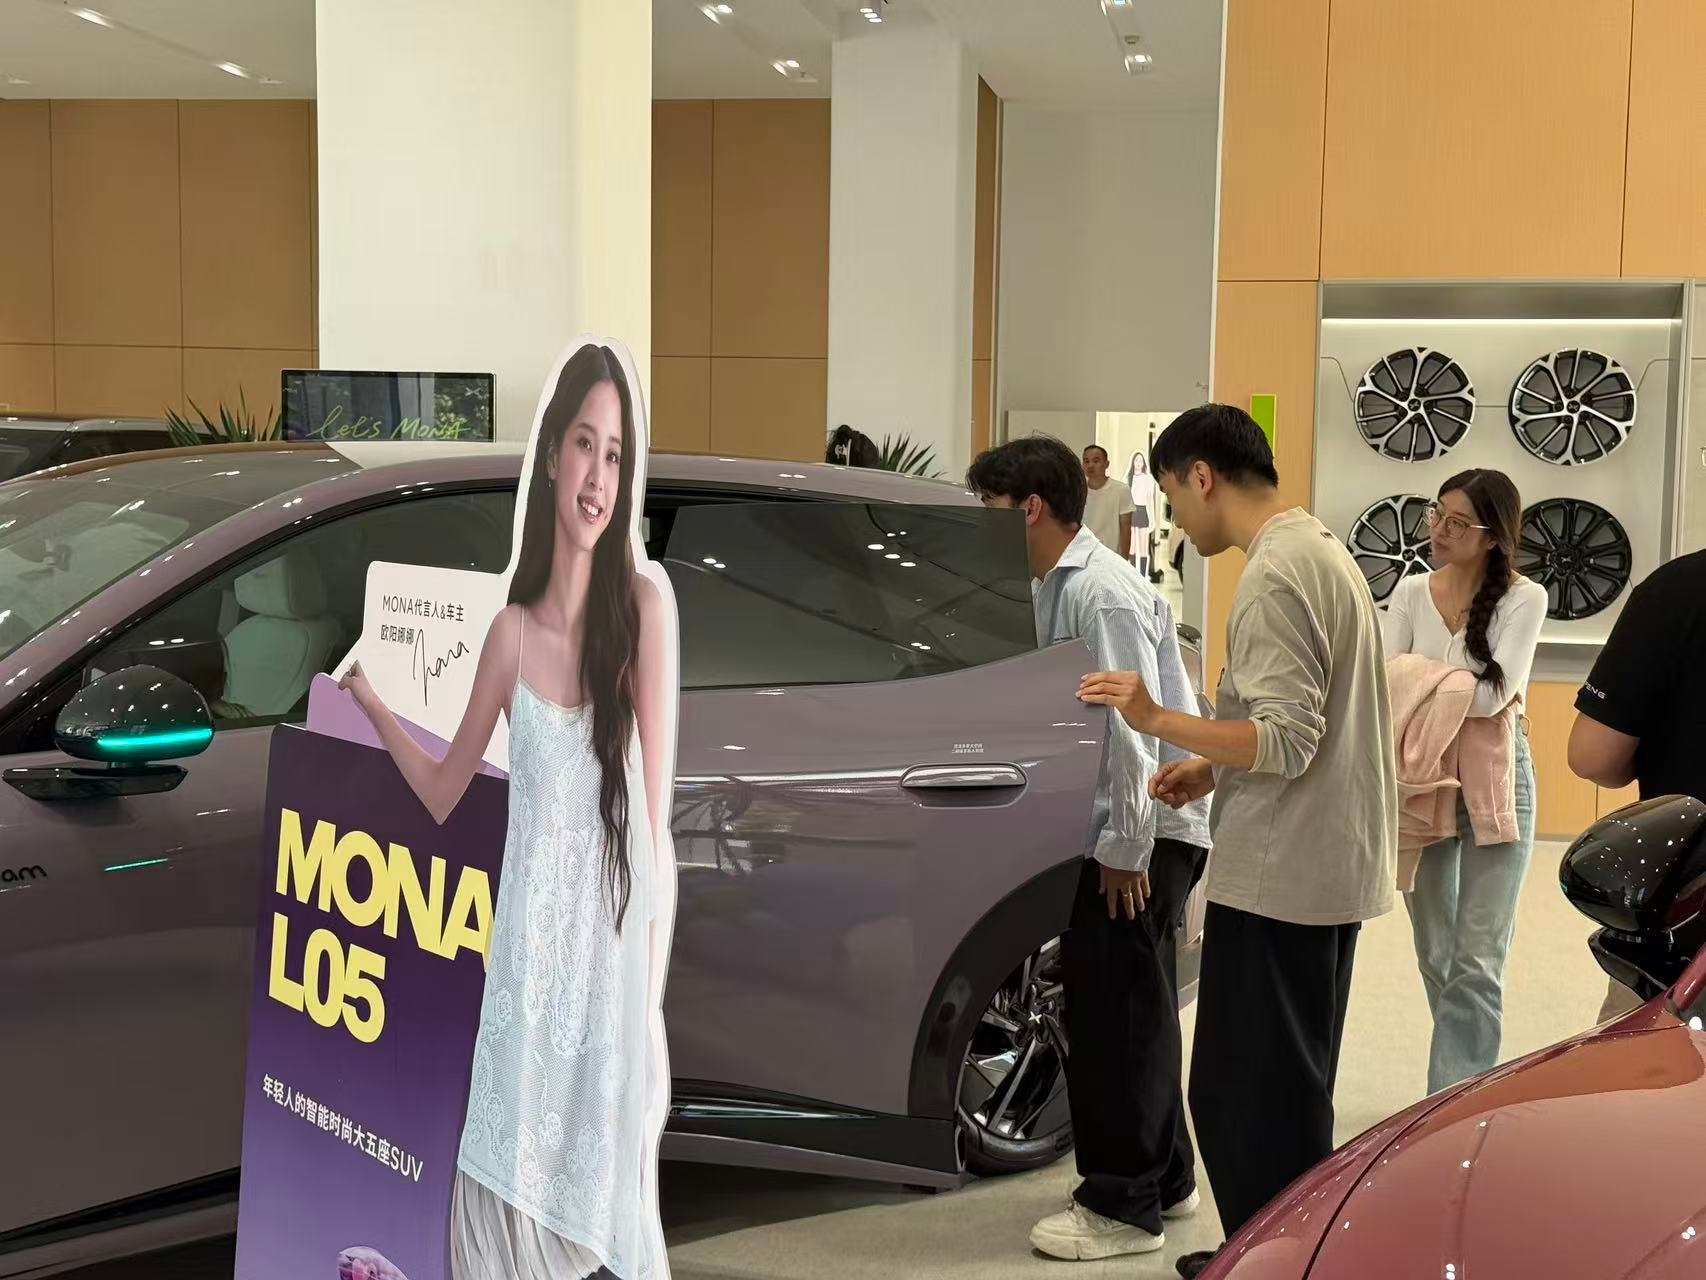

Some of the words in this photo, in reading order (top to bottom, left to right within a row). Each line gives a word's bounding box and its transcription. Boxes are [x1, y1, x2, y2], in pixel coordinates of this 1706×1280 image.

[390, 417, 472, 440] MONA
[380, 624, 415, 645] 欧阳娜娜
[382, 594, 465, 622] MONA代言人&车主
[275, 807, 495, 973] MONA
[268, 911, 386, 1043] L05
[262, 1073, 424, 1183] 年轻人的智能时尚大五座SUV
